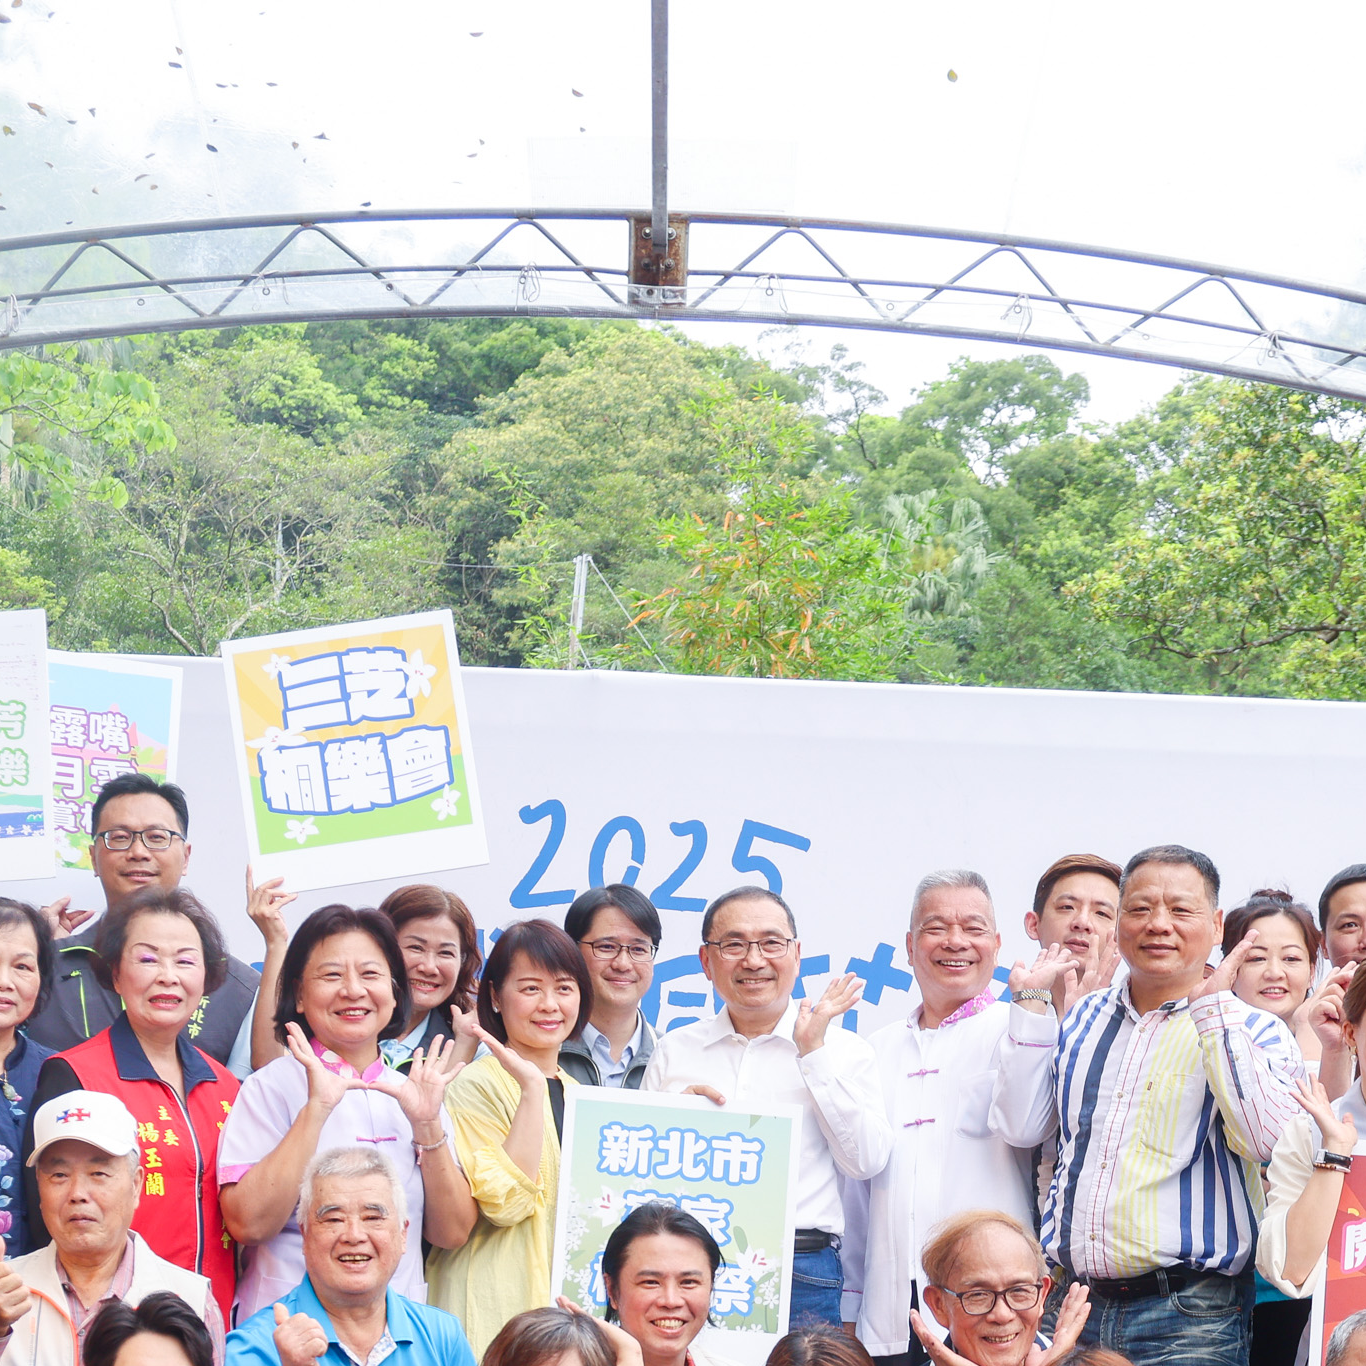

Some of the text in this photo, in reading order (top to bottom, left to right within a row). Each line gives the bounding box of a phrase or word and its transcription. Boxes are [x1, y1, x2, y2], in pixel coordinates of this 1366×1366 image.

[280, 647, 413, 726] 三芝
[258, 725, 453, 815] 桐樂會
[509, 799, 812, 912] 2025
[137, 1122, 165, 1196] 楊玉蘭
[157, 1105, 179, 1146] 主委
[597, 1122, 764, 1185] 新北市
[623, 1190, 734, 1245] 家
